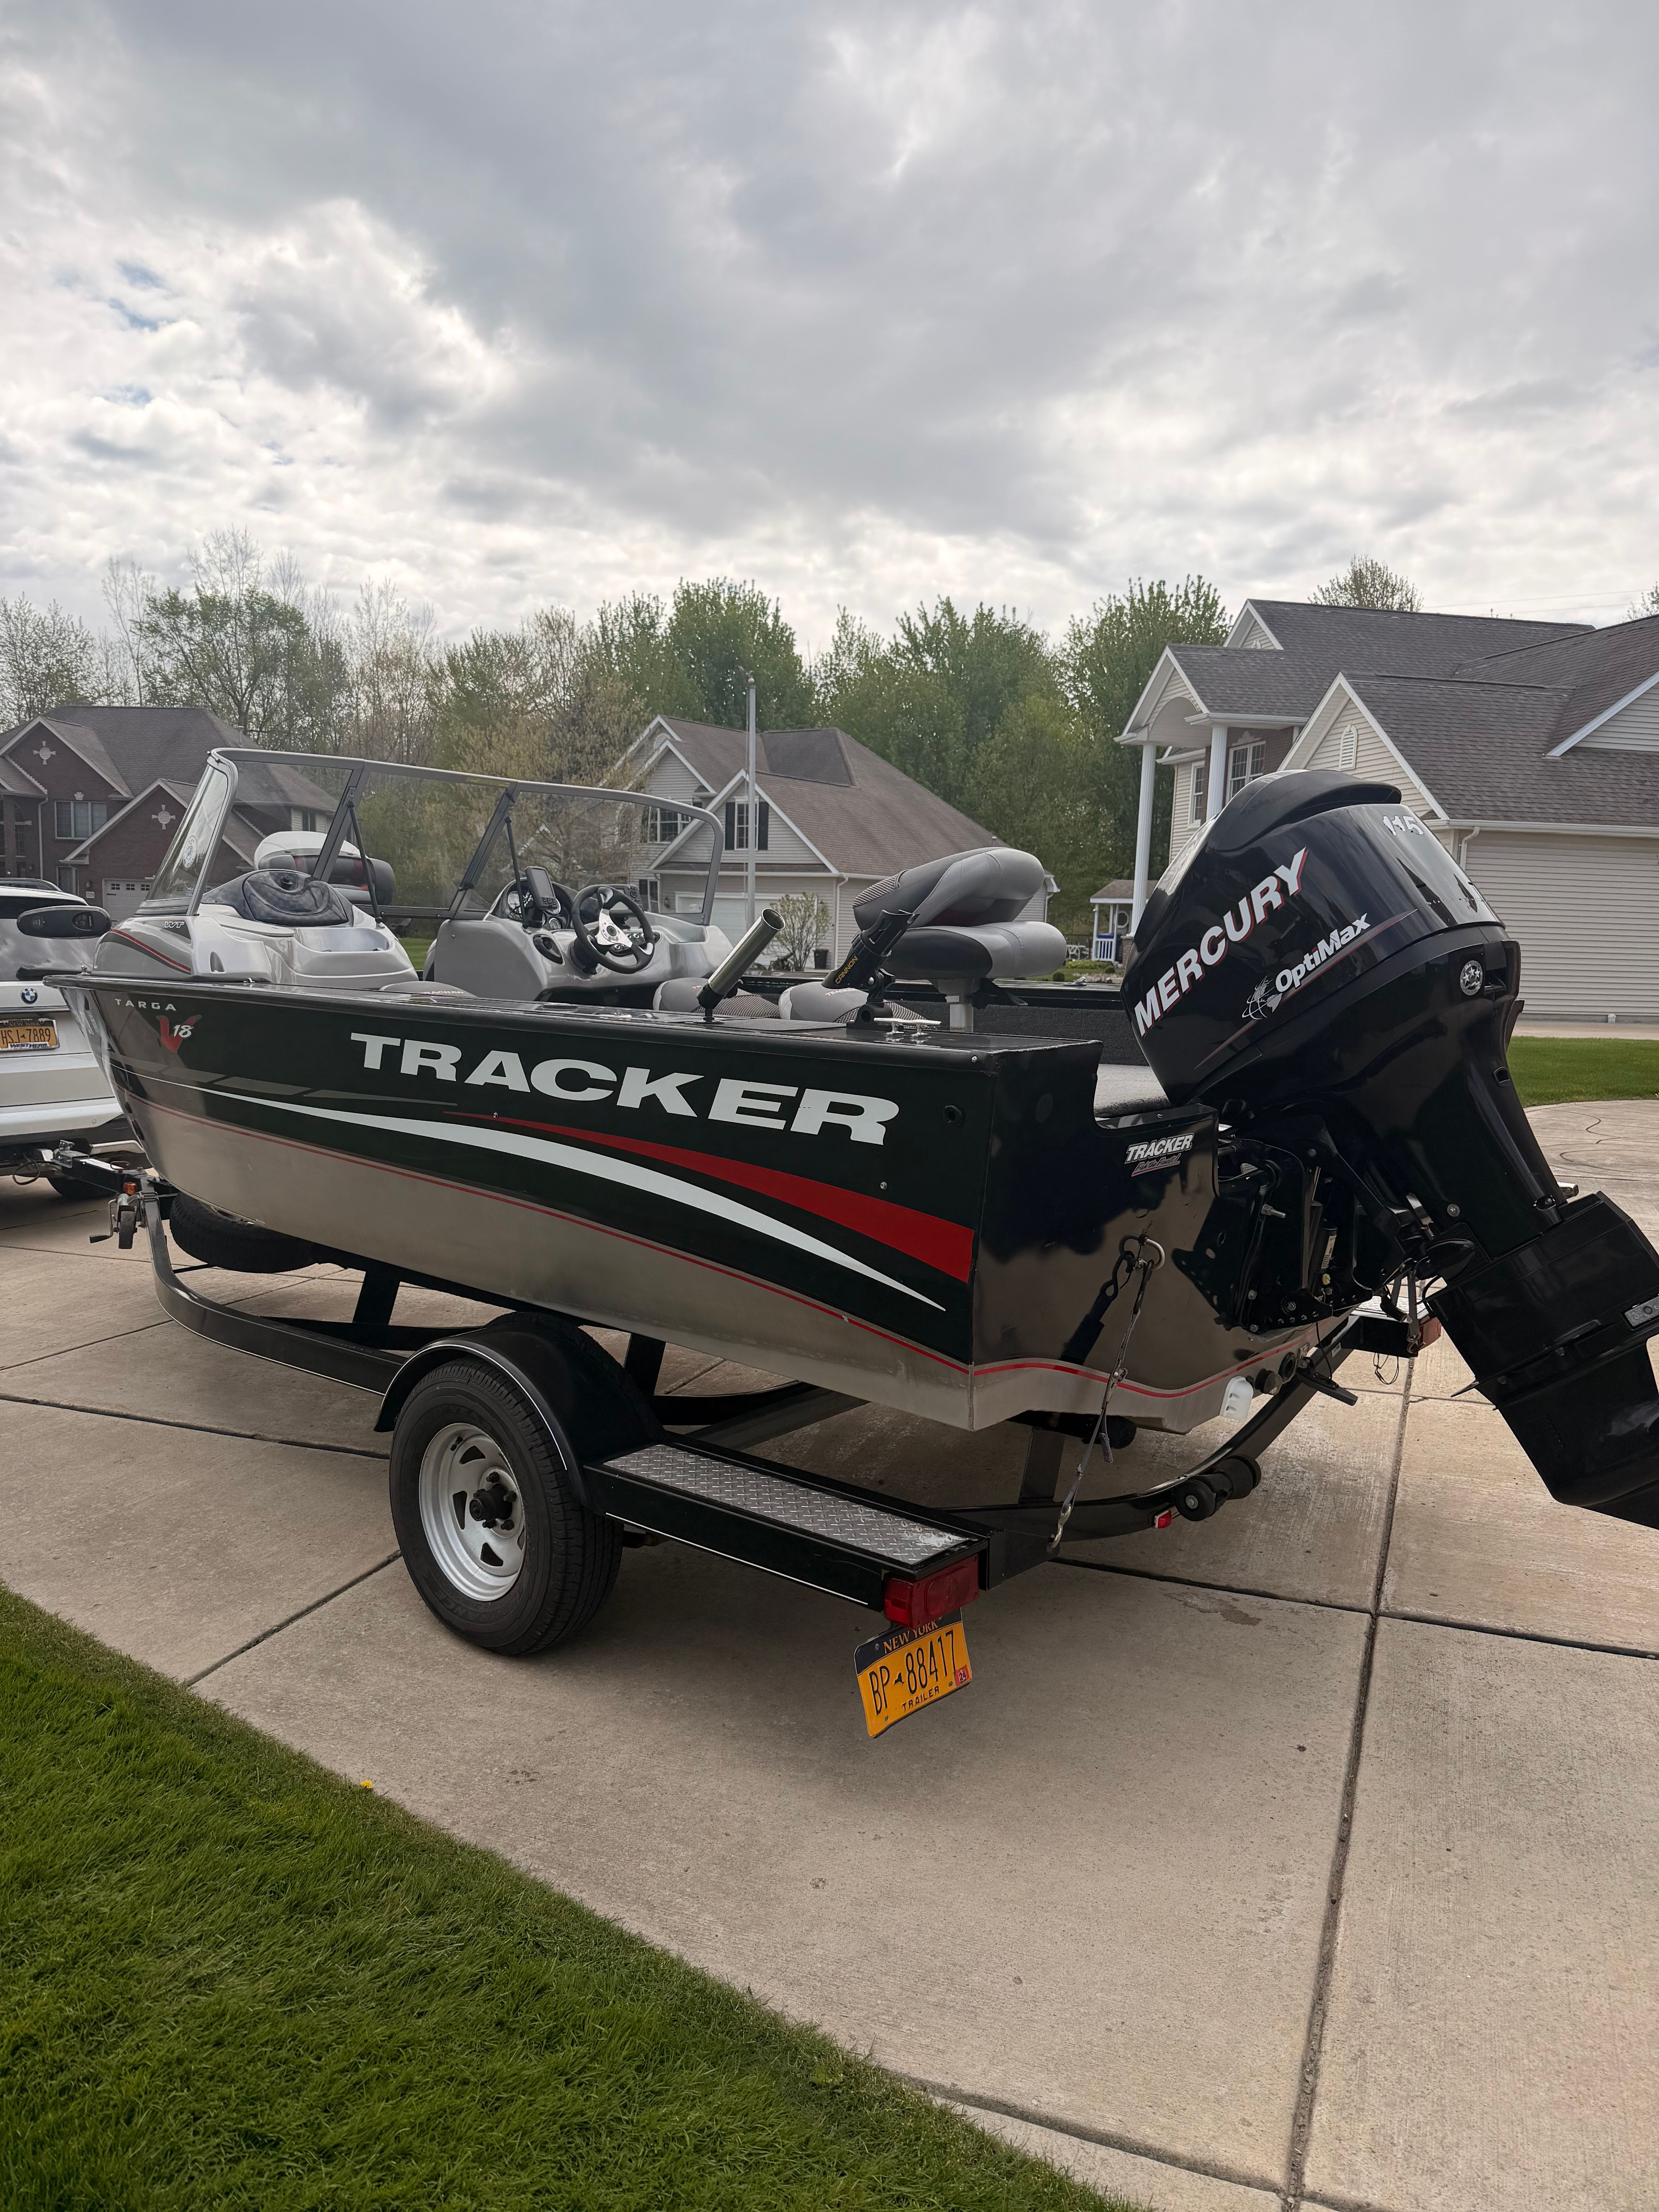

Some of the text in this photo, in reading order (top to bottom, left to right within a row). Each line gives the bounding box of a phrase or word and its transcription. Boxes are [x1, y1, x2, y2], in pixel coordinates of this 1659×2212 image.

[1383, 816, 1424, 836] 115
[1134, 847, 1308, 1038] MERCURY
[1276, 913, 1371, 993] OptiMax
[835, 956, 858, 984] CANNON
[115, 999, 177, 1011] TARGA
[26, 1028, 51, 1042] 7889
[351, 1032, 899, 1145] TRACKER
[1126, 1134, 1194, 1162] TRACKER
[883, 1620, 938, 1654] NEW YORK
[869, 1629, 956, 1716] BP 88417
[959, 1671, 967, 1681] 24
[902, 1686, 939, 1712] TRAILER
